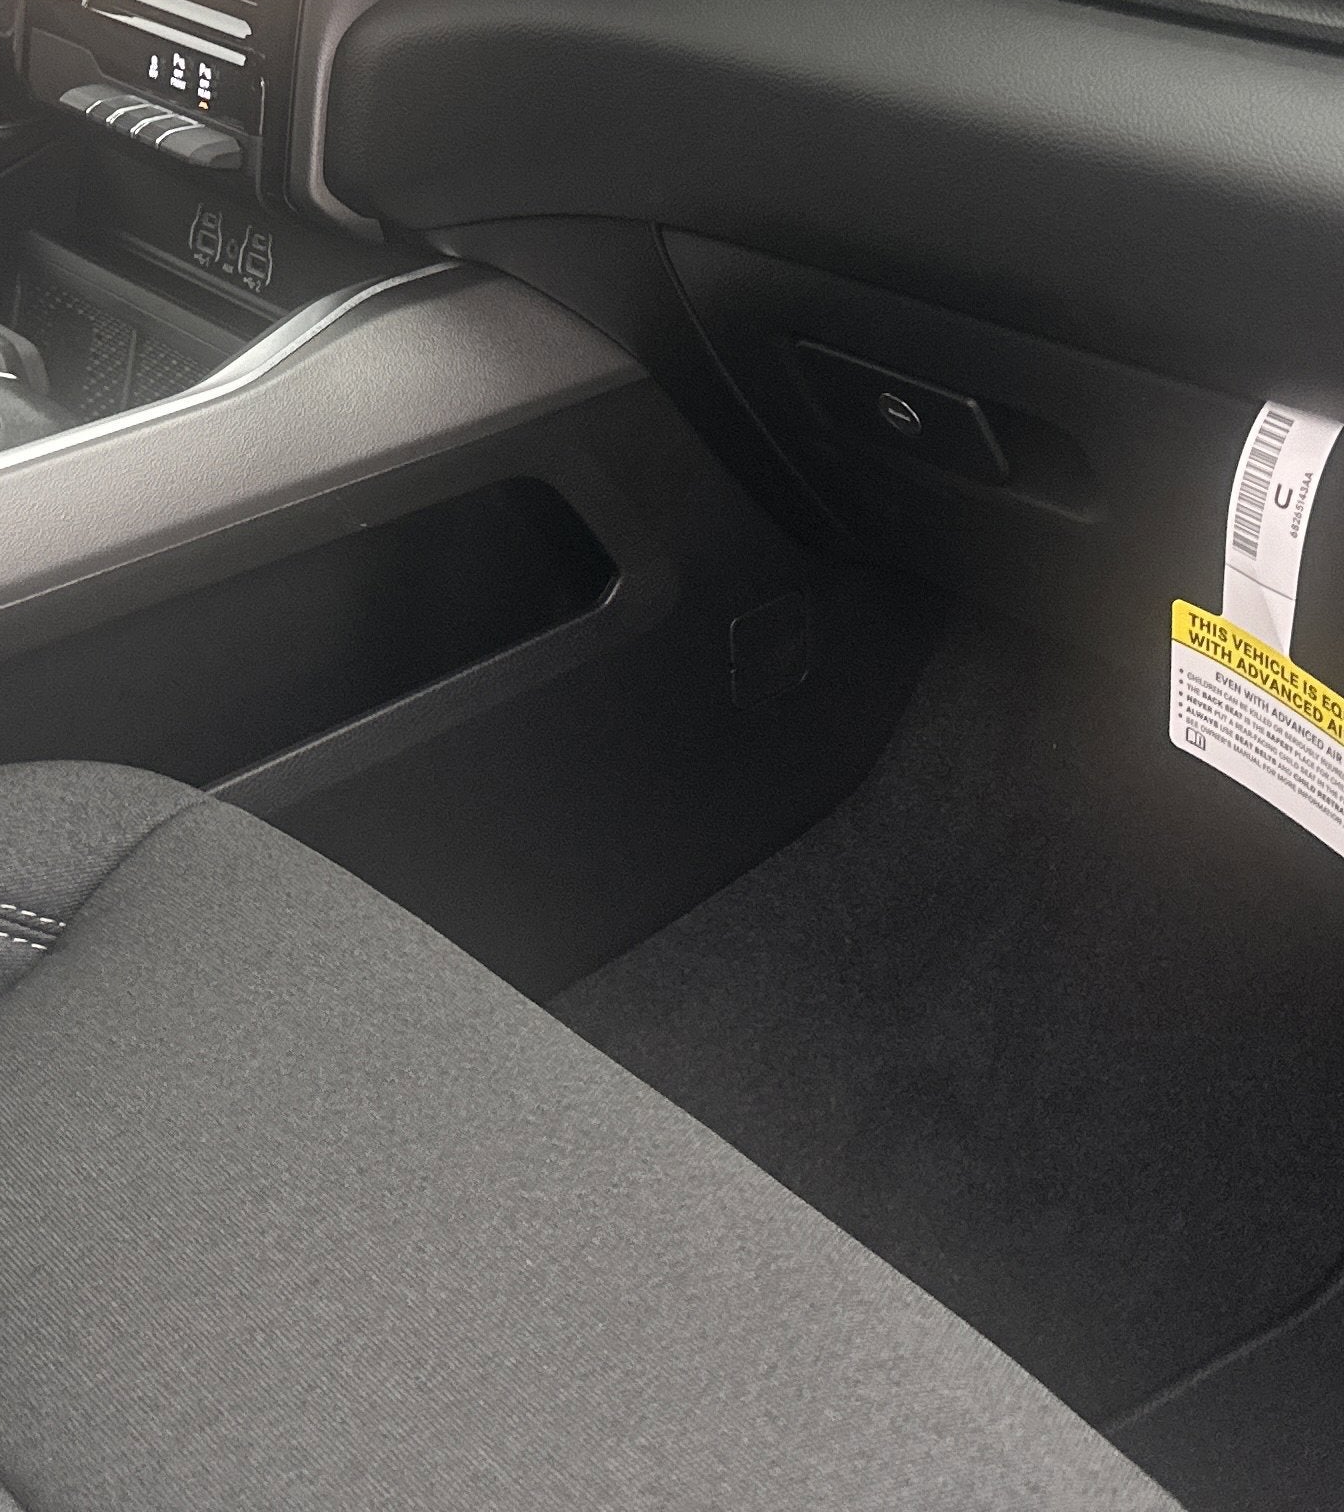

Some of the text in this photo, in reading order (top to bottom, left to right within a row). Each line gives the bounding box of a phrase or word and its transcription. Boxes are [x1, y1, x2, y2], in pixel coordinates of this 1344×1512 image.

[1188, 630, 1232, 663] WITH
[1236, 657, 1324, 723] ADVANCED
[1189, 612, 1228, 642] THIS
[1232, 633, 1299, 688] VEHICLE
[1304, 681, 1318, 701] IS
[1215, 671, 1240, 695] EVEN
[1244, 689, 1268, 713] WITH
[1271, 707, 1323, 751] ADVANCED
[1326, 745, 1341, 763] AIR
